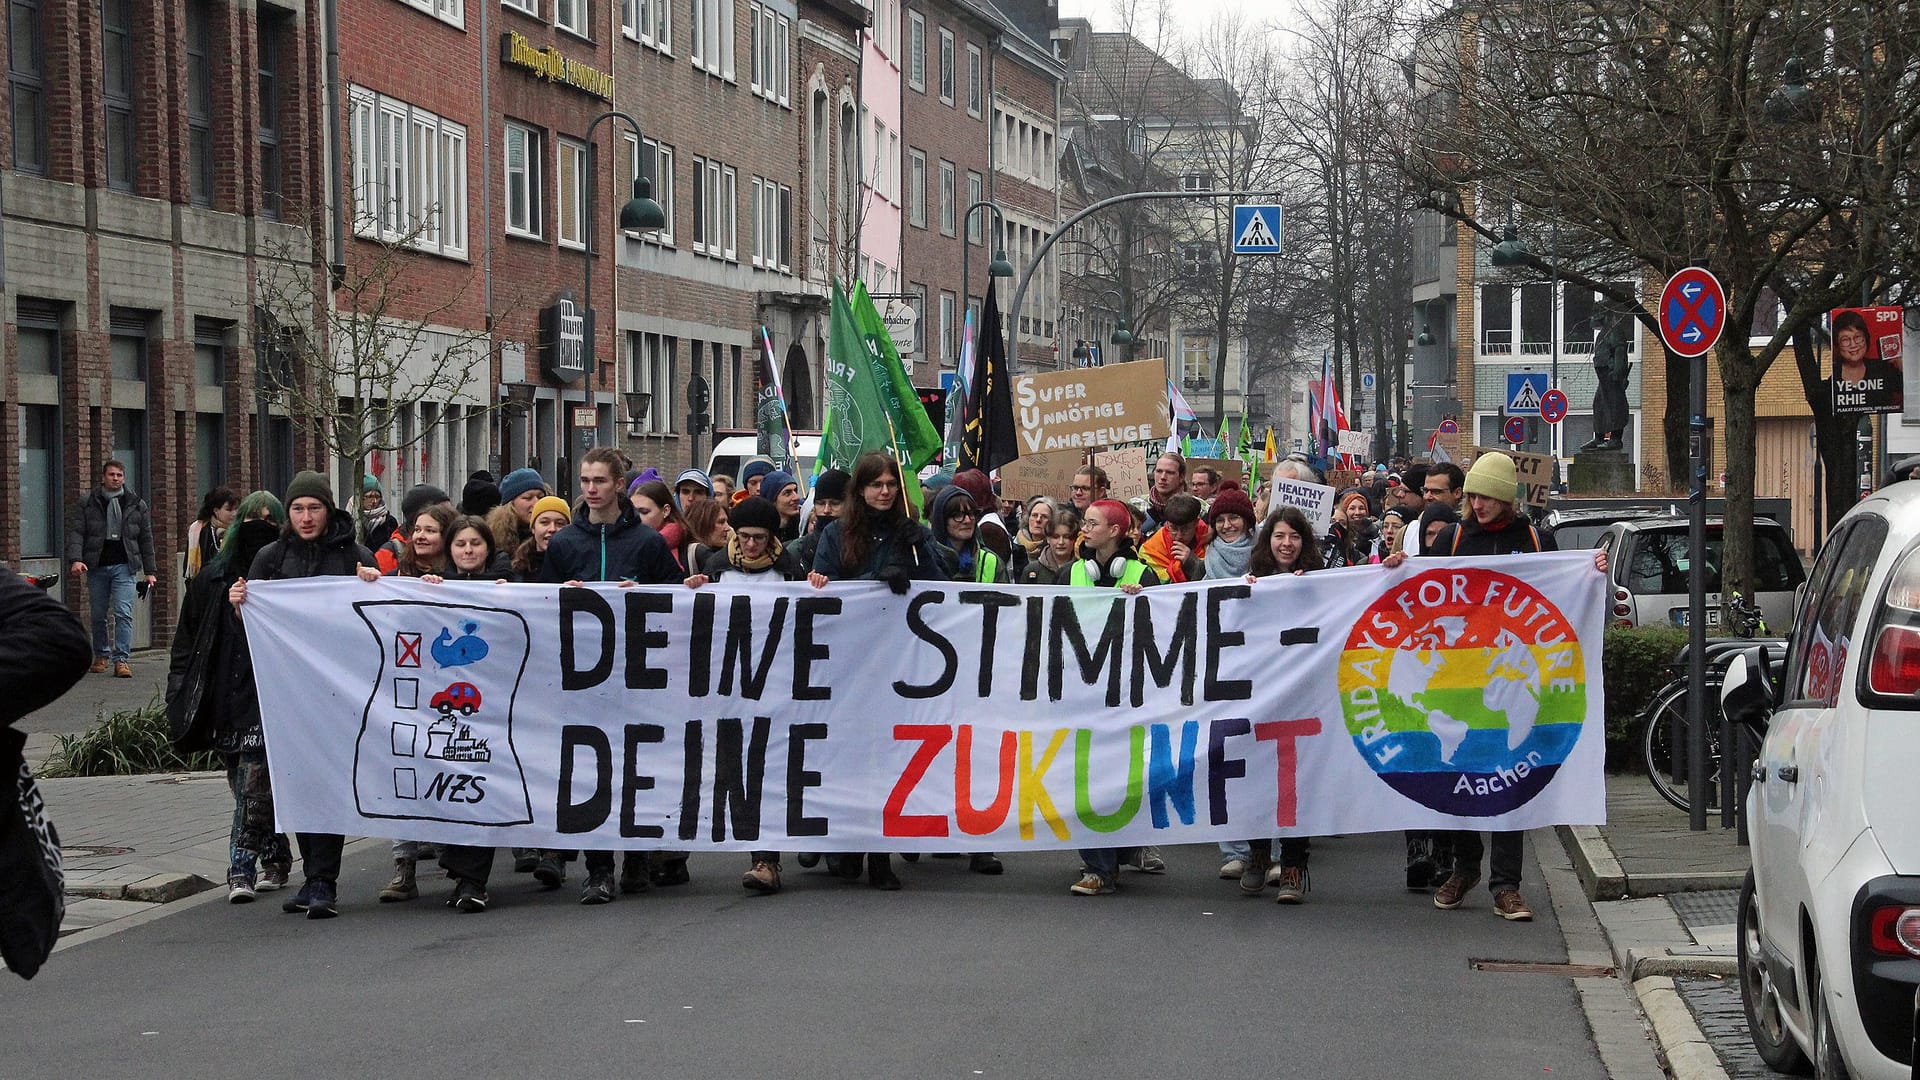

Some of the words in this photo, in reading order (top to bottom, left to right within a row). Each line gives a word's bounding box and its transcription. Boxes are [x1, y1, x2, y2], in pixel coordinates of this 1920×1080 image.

[1876, 311, 1899, 322] SPD
[1883, 343, 1898, 351] SPD
[1836, 379, 1884, 392] YE-ONE
[1837, 393, 1867, 406] RHIE
[1120, 469, 1131, 481] IN
[1123, 483, 1143, 497] AIR
[1278, 482, 1325, 500] HEALTHY
[1282, 494, 1321, 509] PLANET
[558, 586, 842, 700] DEINE
[893, 585, 1251, 708] STIMME
[1351, 612, 1405, 765] FRIDAYS
[1395, 574, 1472, 619] FOR
[1482, 580, 1576, 693] FUTURE
[556, 717, 828, 842] DEINE
[883, 716, 1322, 840] ZUKUNFT
[1453, 749, 1542, 796] Aachen
[424, 772, 487, 804] NZS
